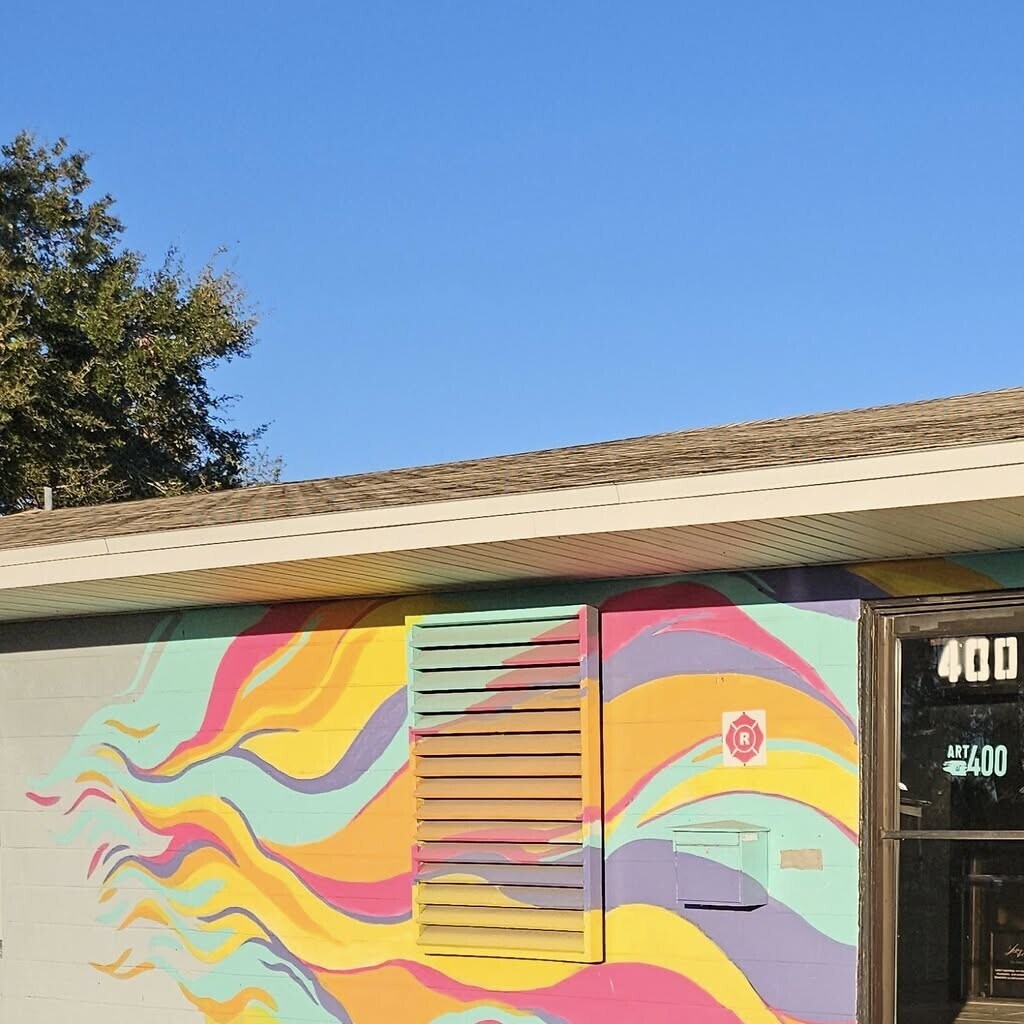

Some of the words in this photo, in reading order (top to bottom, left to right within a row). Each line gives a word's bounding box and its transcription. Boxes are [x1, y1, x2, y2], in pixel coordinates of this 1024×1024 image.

[938, 637, 1018, 683] 400
[739, 732, 750, 746] R
[947, 744, 969, 759] ART
[966, 744, 1008, 777] 400
